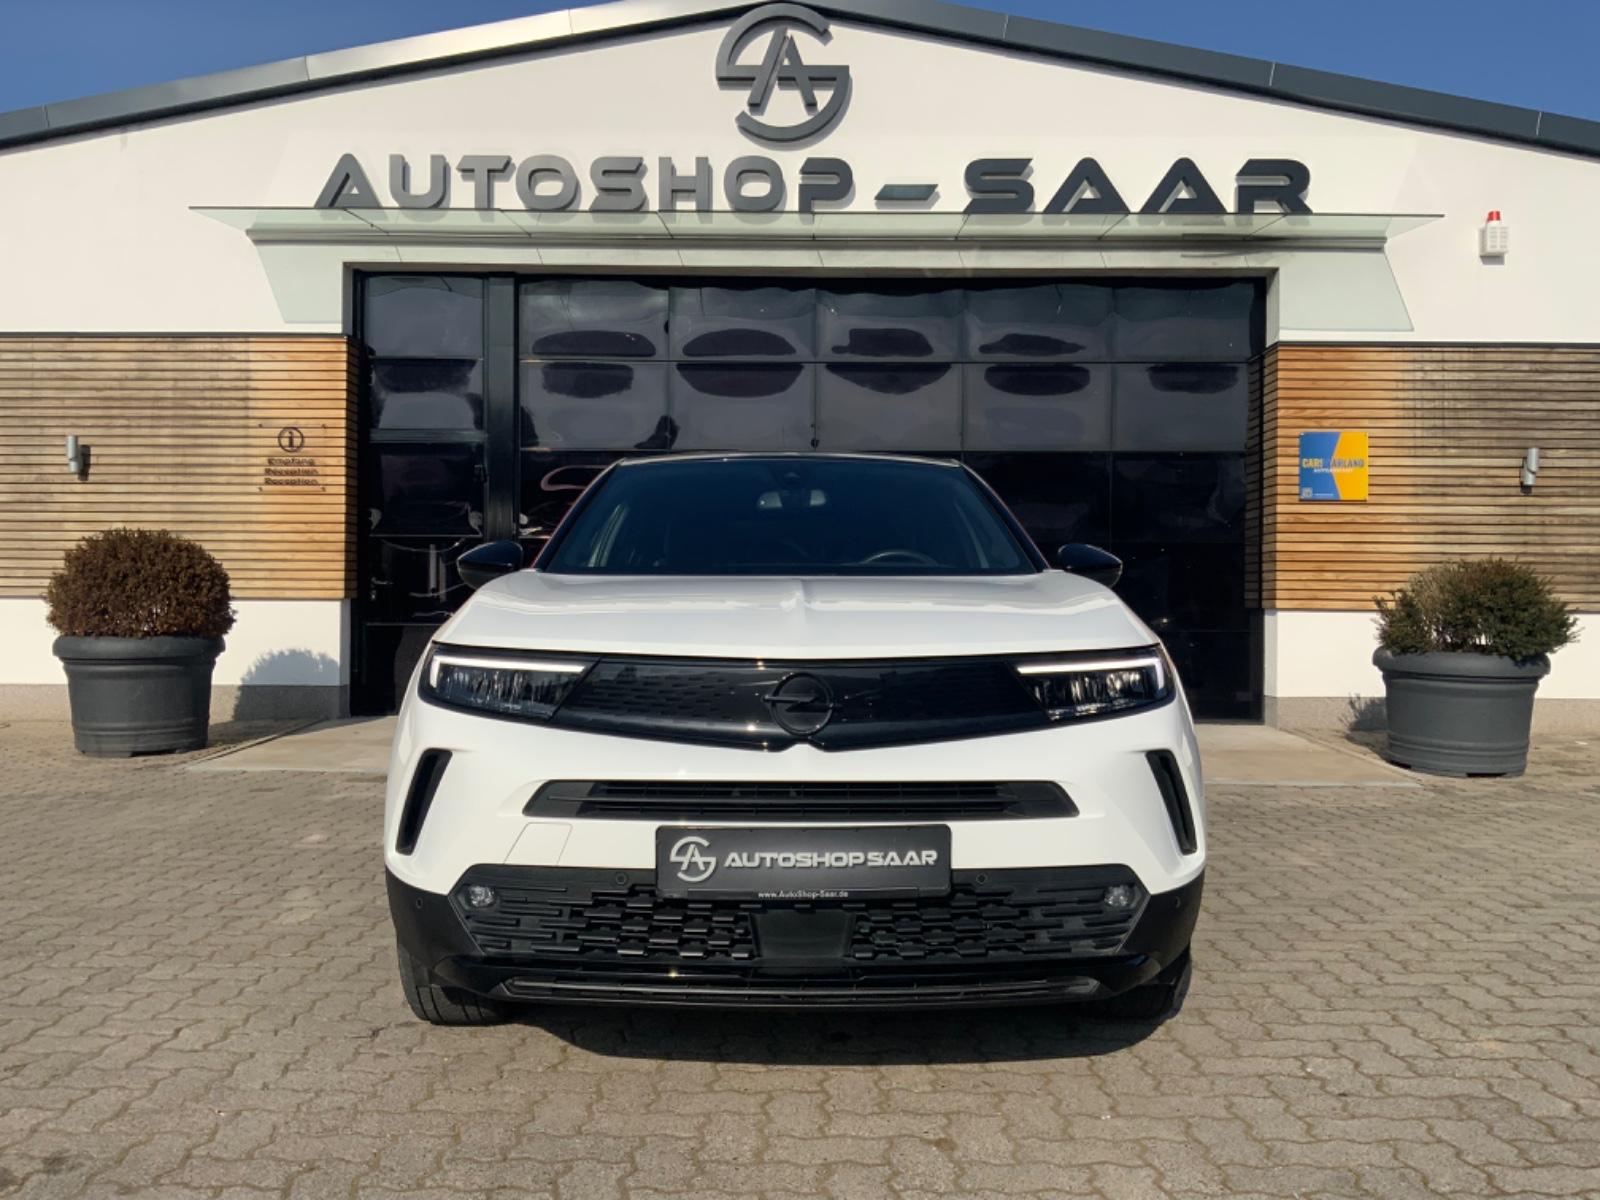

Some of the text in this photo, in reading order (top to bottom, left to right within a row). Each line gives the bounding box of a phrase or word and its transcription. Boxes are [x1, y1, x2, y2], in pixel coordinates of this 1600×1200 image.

[314, 153, 852, 213] AUTOSHOP
[962, 156, 1312, 214] SAAR
[758, 890, 848, 899] www.AutoShop-Saar.de
